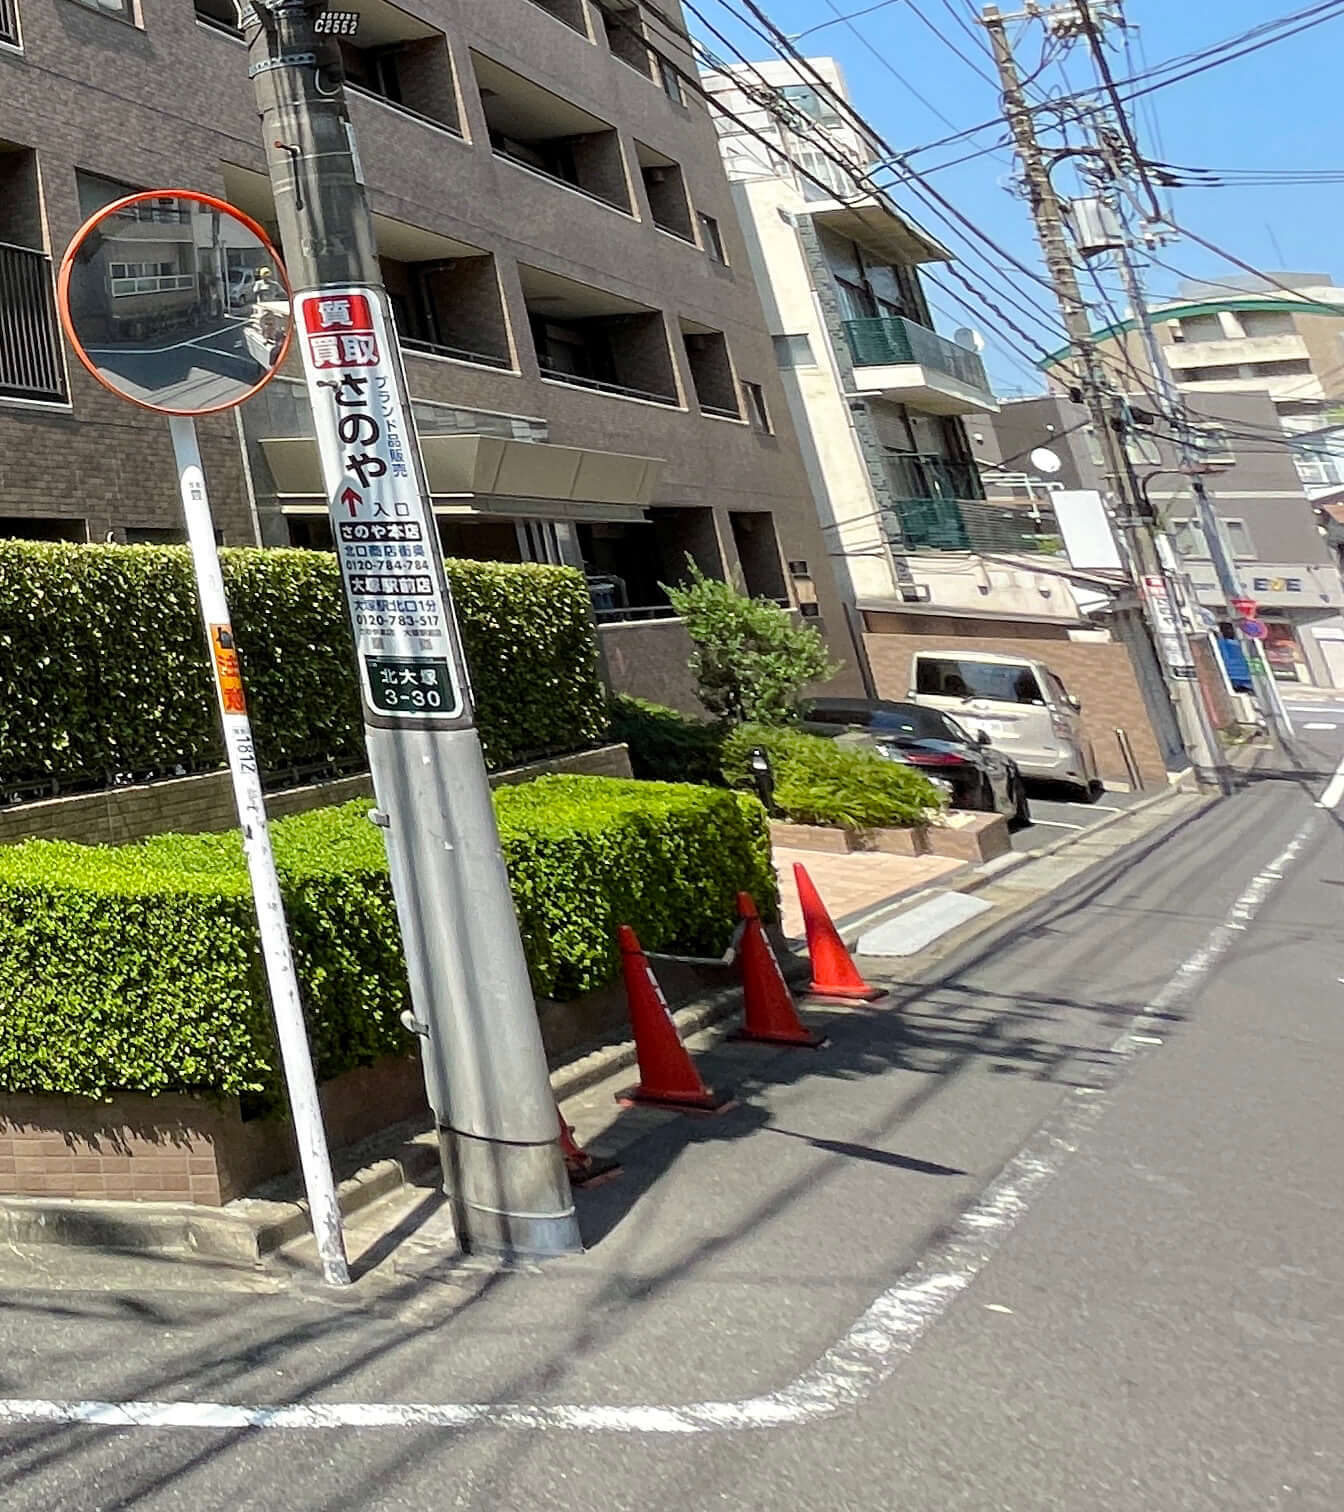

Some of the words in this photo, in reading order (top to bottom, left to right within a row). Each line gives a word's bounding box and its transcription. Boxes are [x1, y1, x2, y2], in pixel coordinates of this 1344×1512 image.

[317, 300, 354, 328] 質
[310, 334, 379, 367] 買取
[335, 373, 388, 489] さのや
[374, 375, 408, 478] ブランド品販売
[373, 502, 410, 517] 入口
[341, 523, 421, 540] さのや本店
[345, 559, 430, 571] 0120-784-784
[356, 615, 439, 626] 0120-783-517
[384, 689, 441, 707] 3-30
